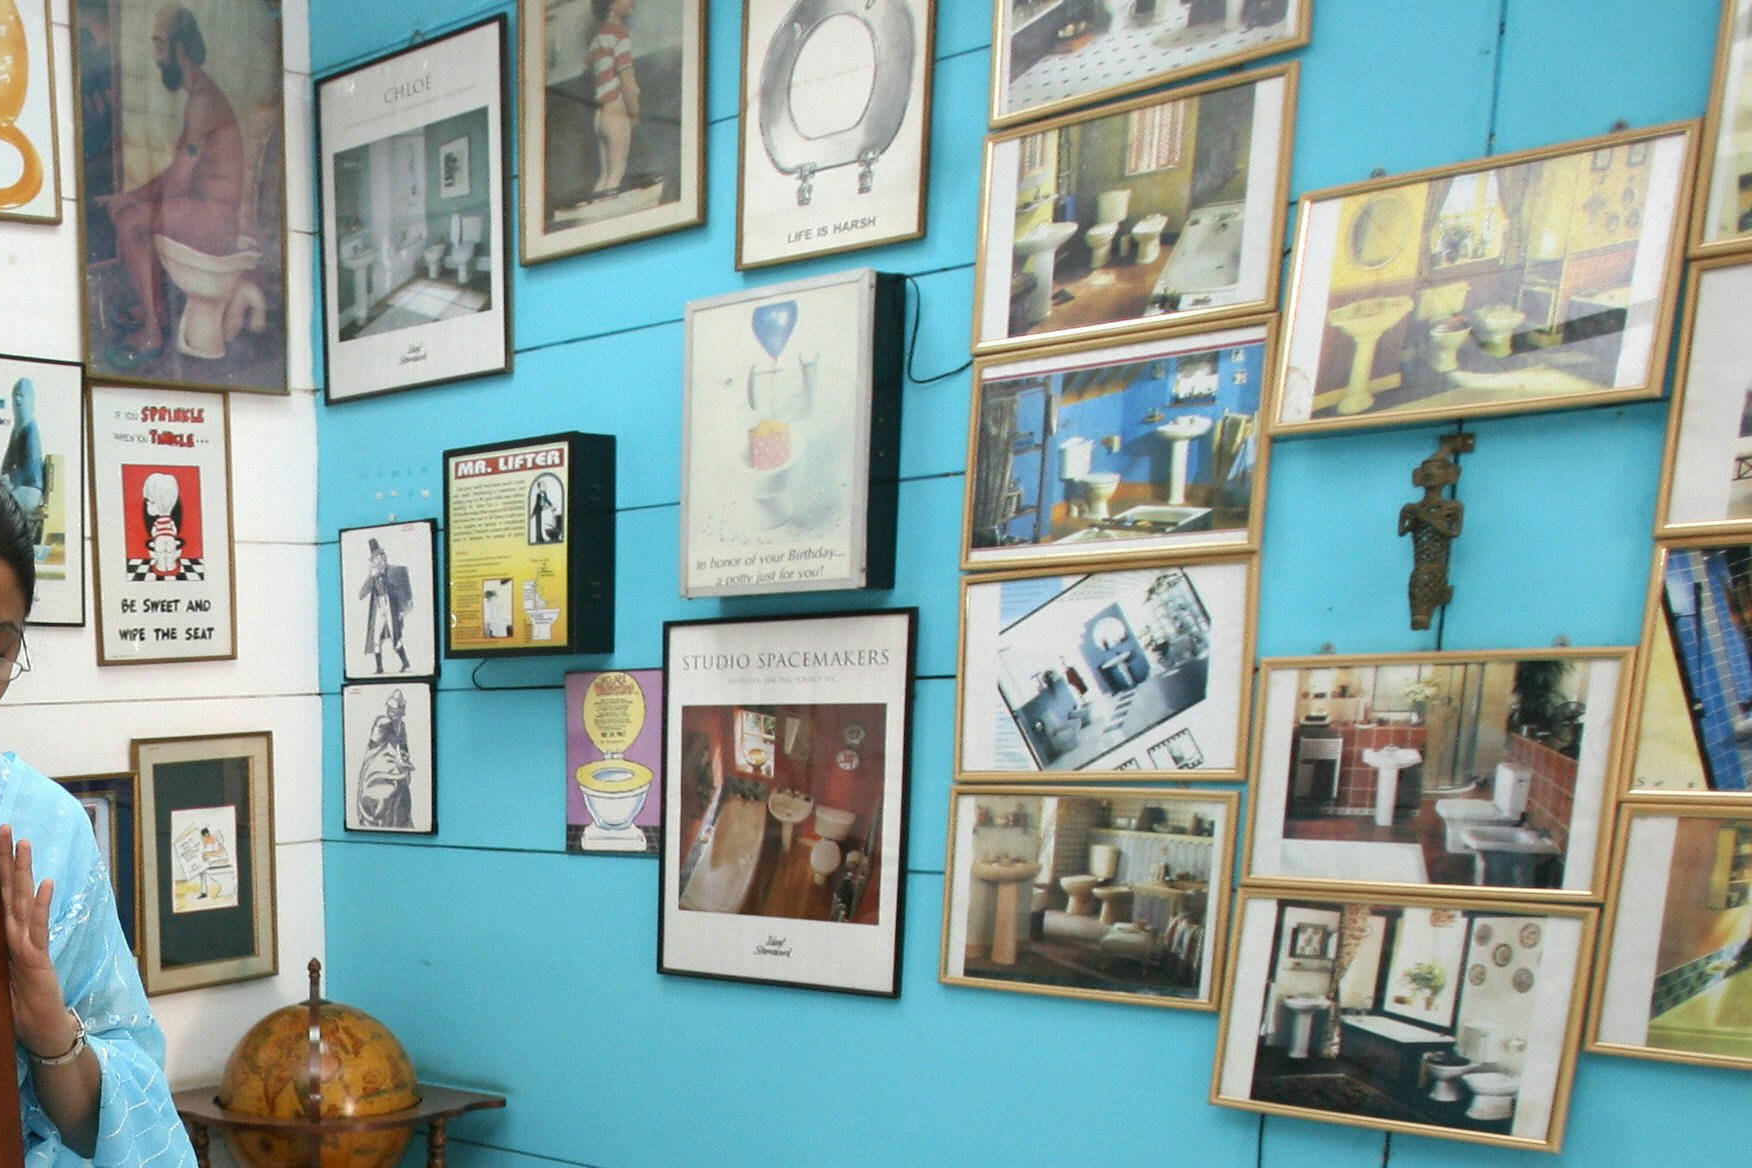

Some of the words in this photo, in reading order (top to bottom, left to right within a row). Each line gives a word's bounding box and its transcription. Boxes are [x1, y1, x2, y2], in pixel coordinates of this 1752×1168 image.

[787, 228, 812, 243] LIFE
[816, 225, 829, 237] IS
[832, 216, 877, 234] HARSH
[140, 405, 205, 423] SPRINKLE
[457, 459, 493, 477] MR.
[498, 450, 561, 472] LIFTER
[710, 557, 742, 570] honor
[743, 554, 756, 566] of
[759, 552, 785, 565] your
[756, 569, 777, 584] just
[779, 568, 795, 580] for
[798, 566, 825, 579] you!
[121, 598, 137, 613] BE
[143, 598, 181, 613] SWEET
[186, 598, 212, 613] AND
[118, 627, 146, 641] WIPE
[153, 627, 178, 641] THE
[185, 626, 215, 641] SEAT
[682, 653, 751, 671] STUDIO
[756, 648, 891, 670] SPACEMAKERS
